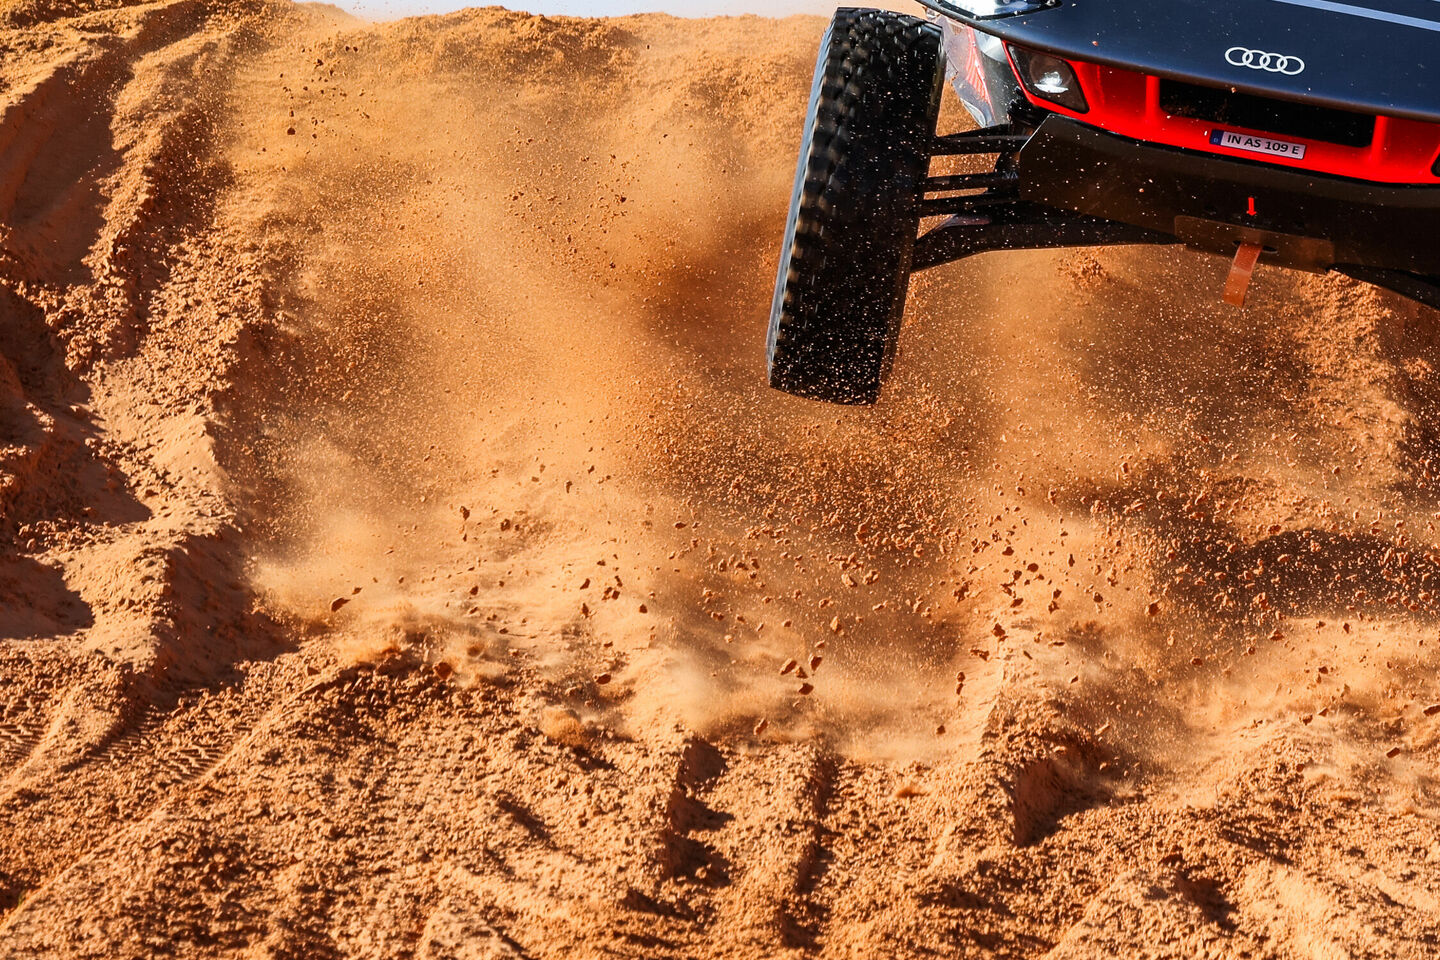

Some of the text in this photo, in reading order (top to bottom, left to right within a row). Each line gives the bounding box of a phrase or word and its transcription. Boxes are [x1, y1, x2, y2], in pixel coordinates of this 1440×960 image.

[1227, 134, 1241, 145] IN
[1244, 138, 1261, 148] AS
[1265, 141, 1288, 152] 109
[1292, 146, 1300, 154] E
